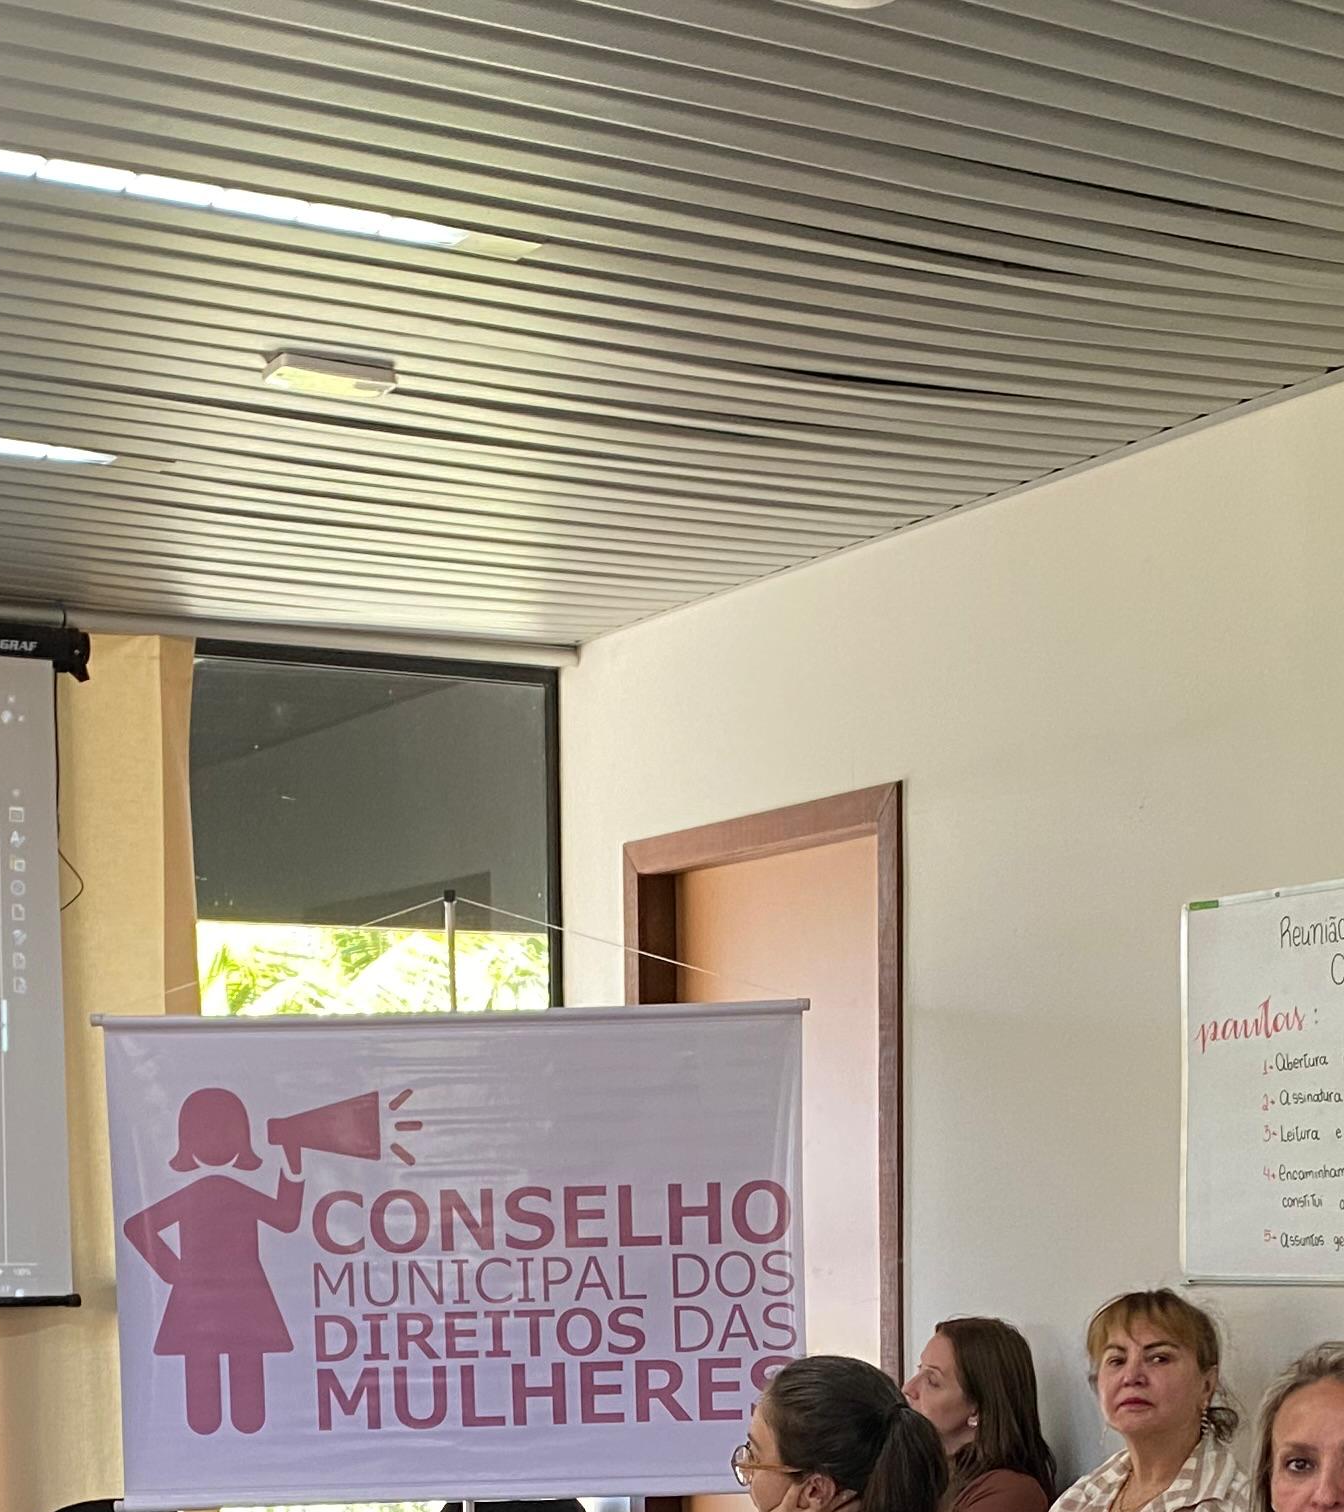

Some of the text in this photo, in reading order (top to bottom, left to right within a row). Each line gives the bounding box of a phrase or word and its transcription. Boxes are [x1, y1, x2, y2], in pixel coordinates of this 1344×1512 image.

[1280, 1124, 1321, 1143] Leitura
[1335, 1127, 1343, 1139] e
[311, 1179, 792, 1256] CONSELHO
[312, 1249, 796, 1309] MUNICIPAL DOS
[313, 1302, 798, 1364] DIREITOS DAS
